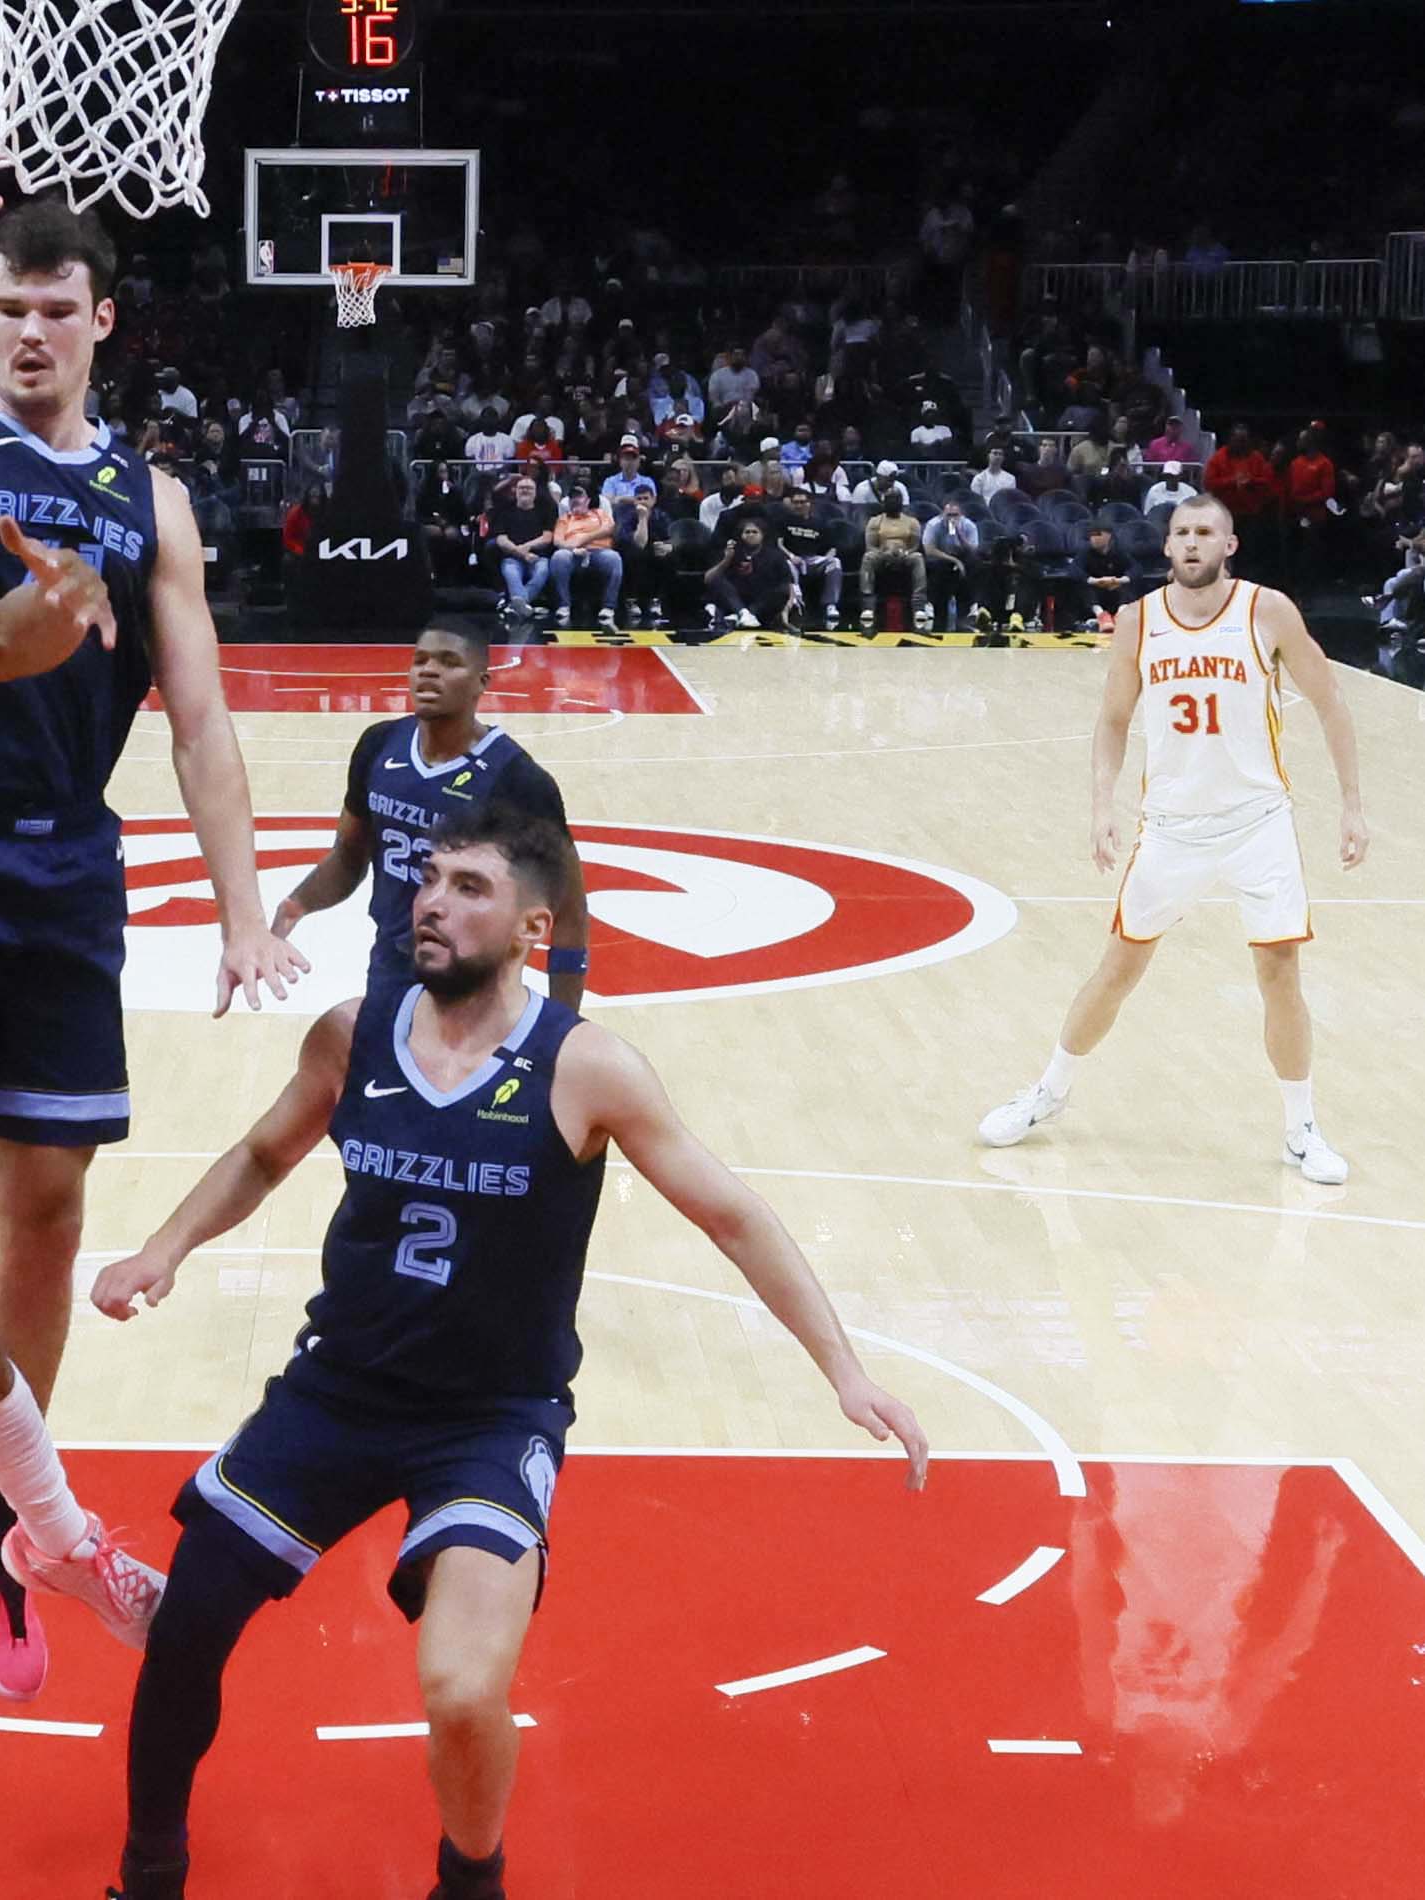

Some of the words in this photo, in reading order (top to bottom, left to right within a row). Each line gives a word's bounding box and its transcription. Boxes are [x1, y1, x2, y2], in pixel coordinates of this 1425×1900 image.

[351, 15, 394, 65] 16
[341, 88, 410, 103] TISSOT
[319, 538, 408, 560] KIA
[1149, 656, 1247, 685] ATLANTA
[1169, 693, 1221, 735] 31
[342, 1139, 530, 1196] GRIZZLIES
[394, 1202, 458, 1286] 2
